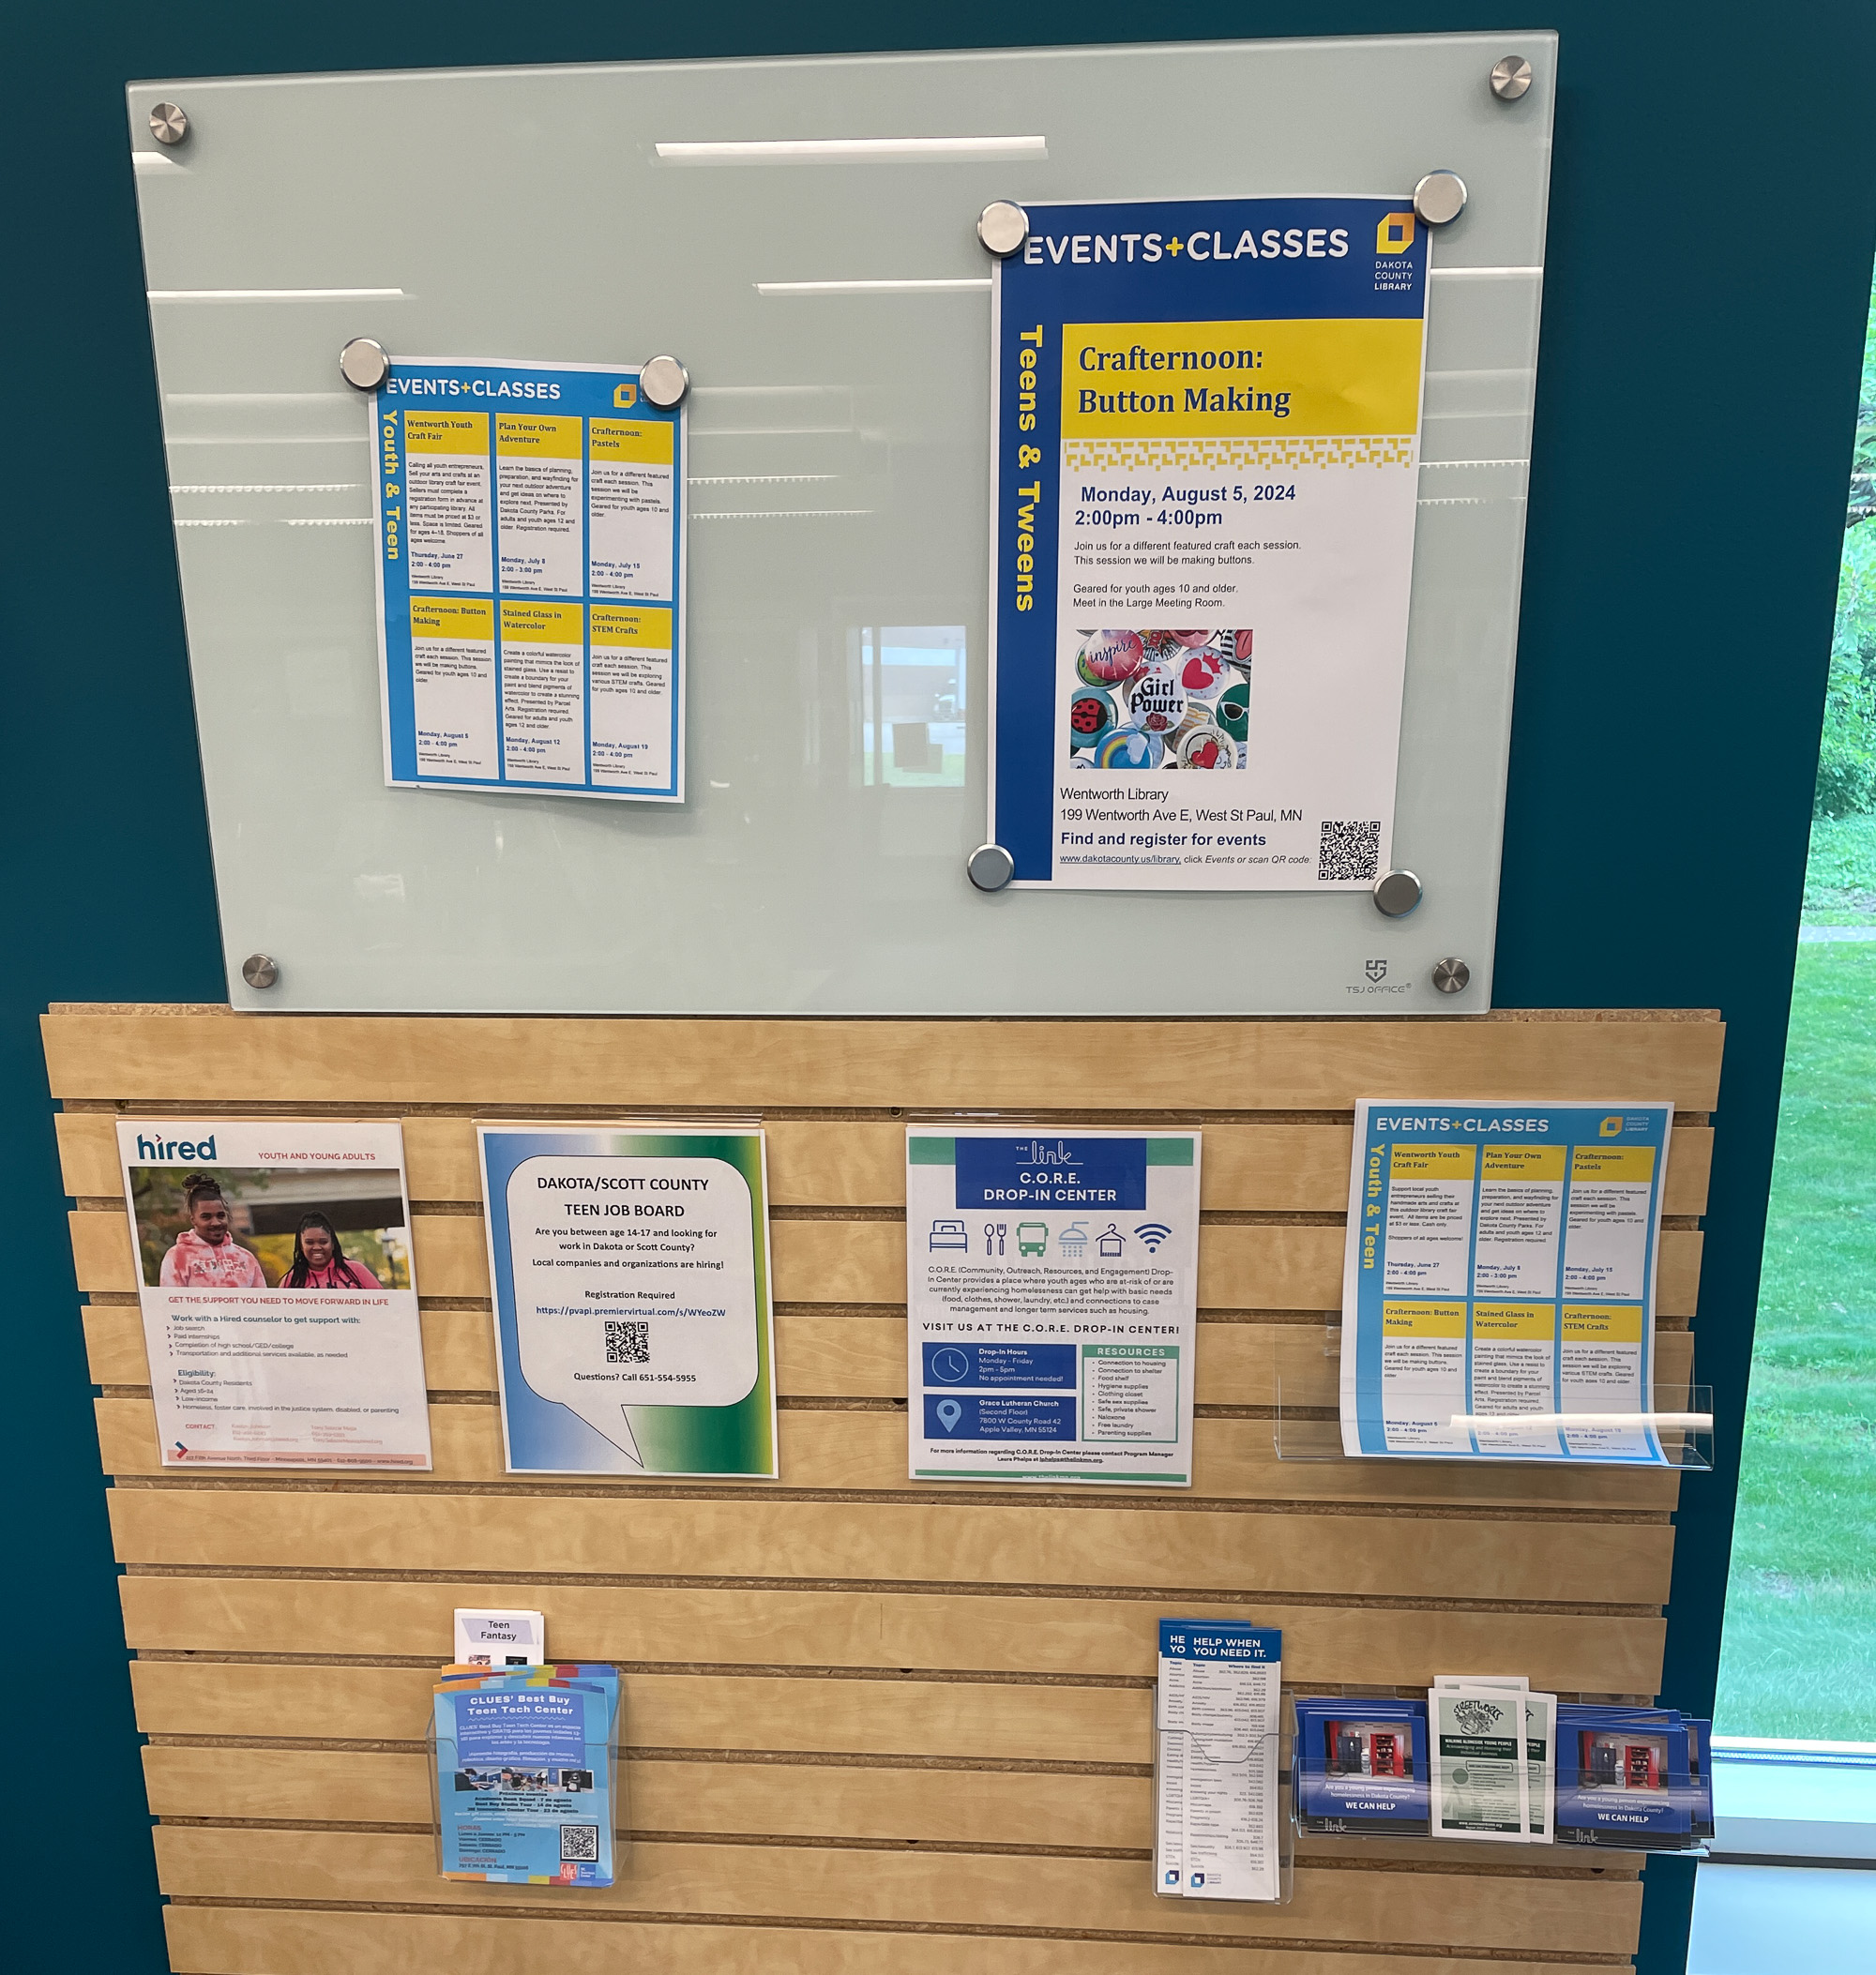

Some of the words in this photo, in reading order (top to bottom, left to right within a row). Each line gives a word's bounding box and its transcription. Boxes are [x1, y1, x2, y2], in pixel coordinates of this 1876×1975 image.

[1024, 228, 1349, 264] EVENTS+CLASSES
[1375, 261, 1413, 269] DAKOTA
[1374, 271, 1412, 279] COUNTY
[1078, 344, 1263, 371] Crafternoon:
[1018, 324, 1044, 431] Teens
[386, 378, 562, 400] EVENTS+CLASSES
[1078, 388, 1174, 414] Button
[1183, 384, 1291, 417] Making
[406, 419, 449, 430] Wentworth
[450, 420, 473, 430] Youth
[497, 421, 517, 430] Plan
[517, 423, 537, 431] Your
[537, 424, 556, 432] Own
[407, 431, 426, 441] Craft
[427, 431, 443, 441] Fair
[591, 427, 643, 438] Crafternoon:
[383, 410, 399, 474] Youth
[497, 433, 539, 444] Adventure
[592, 440, 620, 449] Pastels
[1018, 444, 1041, 469] &
[1081, 486, 1155, 505] Monday,
[1161, 486, 1227, 505] August
[1233, 485, 1247, 504] 5,
[1253, 484, 1295, 500] 2024
[1075, 509, 1139, 529] 2:00pm
[1157, 509, 1221, 528] 4:00pm
[386, 506, 401, 560] Teen
[1016, 480, 1041, 612] Tweens
[1074, 541, 1093, 550] Join
[1110, 540, 1122, 550] for
[1132, 540, 1171, 550] different
[1173, 540, 1211, 550] featured
[1214, 540, 1234, 550] craft
[1237, 540, 1260, 550] each
[1263, 540, 1303, 550] session.
[413, 605, 460, 615] Crafternoon:
[459, 606, 487, 615] Button
[502, 609, 532, 619] Stained
[534, 610, 552, 620] Glass
[413, 616, 441, 626] Making
[592, 613, 642, 624] Crafternoon:
[502, 620, 546, 630] Watercolor
[590, 624, 613, 633] STEM
[1088, 640, 1137, 667] inspire
[1141, 677, 1174, 697] Girl
[1130, 691, 1185, 715] Power
[1060, 787, 1124, 799] Wentworth
[1127, 788, 1169, 803] Library
[1061, 808, 1082, 820] 199
[1085, 808, 1149, 821] Wentworth
[1152, 808, 1176, 821] Ave
[1180, 808, 1191, 822] E,
[1195, 808, 1227, 821] West
[1230, 808, 1243, 821] St
[1246, 808, 1276, 822] Paul,
[1280, 808, 1302, 821] MN
[1061, 832, 1093, 844] Find
[1097, 832, 1125, 845] and
[1129, 832, 1188, 848] register
[1191, 833, 1213, 845] for
[1217, 834, 1265, 845] events
[1345, 986, 1365, 994] TSJ
[1376, 1117, 1549, 1132] EVENTS+CLASSES
[136, 1133, 217, 1160] hired
[1031, 1139, 1074, 1165] link
[1368, 1144, 1385, 1197] Youth
[1020, 1172, 1080, 1183] C.O.R.E.
[537, 1176, 645, 1191] DAKOTA/SCOTT
[649, 1178, 708, 1190] COUNTY
[984, 1188, 1050, 1200] DROP-IN
[1054, 1189, 1116, 1200] CENTER
[564, 1203, 599, 1215] TEEN
[603, 1204, 629, 1215] JOB
[634, 1204, 684, 1216] BOARD
[552, 1229, 567, 1237] you
[569, 1228, 607, 1236] between
[610, 1229, 625, 1238] age
[671, 1229, 703, 1239] looking
[704, 1229, 717, 1237] for
[1363, 1223, 1380, 1269] Teen
[584, 1290, 635, 1300] Registration
[637, 1290, 675, 1300] Required
[922, 1322, 953, 1331] VISIT
[996, 1323, 1019, 1332] THE
[1022, 1323, 1069, 1332] C.O.R.E.
[1074, 1324, 1124, 1333] DROP-IN
[1128, 1325, 1179, 1334] CENTER!
[978, 1348, 1006, 1356] Drop-In
[1097, 1347, 1165, 1356] RESOURCES
[573, 1372, 619, 1380] Questions?
[639, 1373, 696, 1381] 651-554-5955
[480, 1631, 516, 1641] Fantasy
[1225, 1638, 1260, 1647] WHEN
[1193, 1647, 1217, 1655] YOU
[1220, 1648, 1250, 1657] NEED
[1254, 1649, 1268, 1657] IT.
[470, 1695, 513, 1704] CLUES'
[549, 1695, 569, 1705] Buy
[501, 1705, 530, 1713] Tech
[534, 1705, 573, 1714] Center
[1611, 1814, 1627, 1822] CAN
